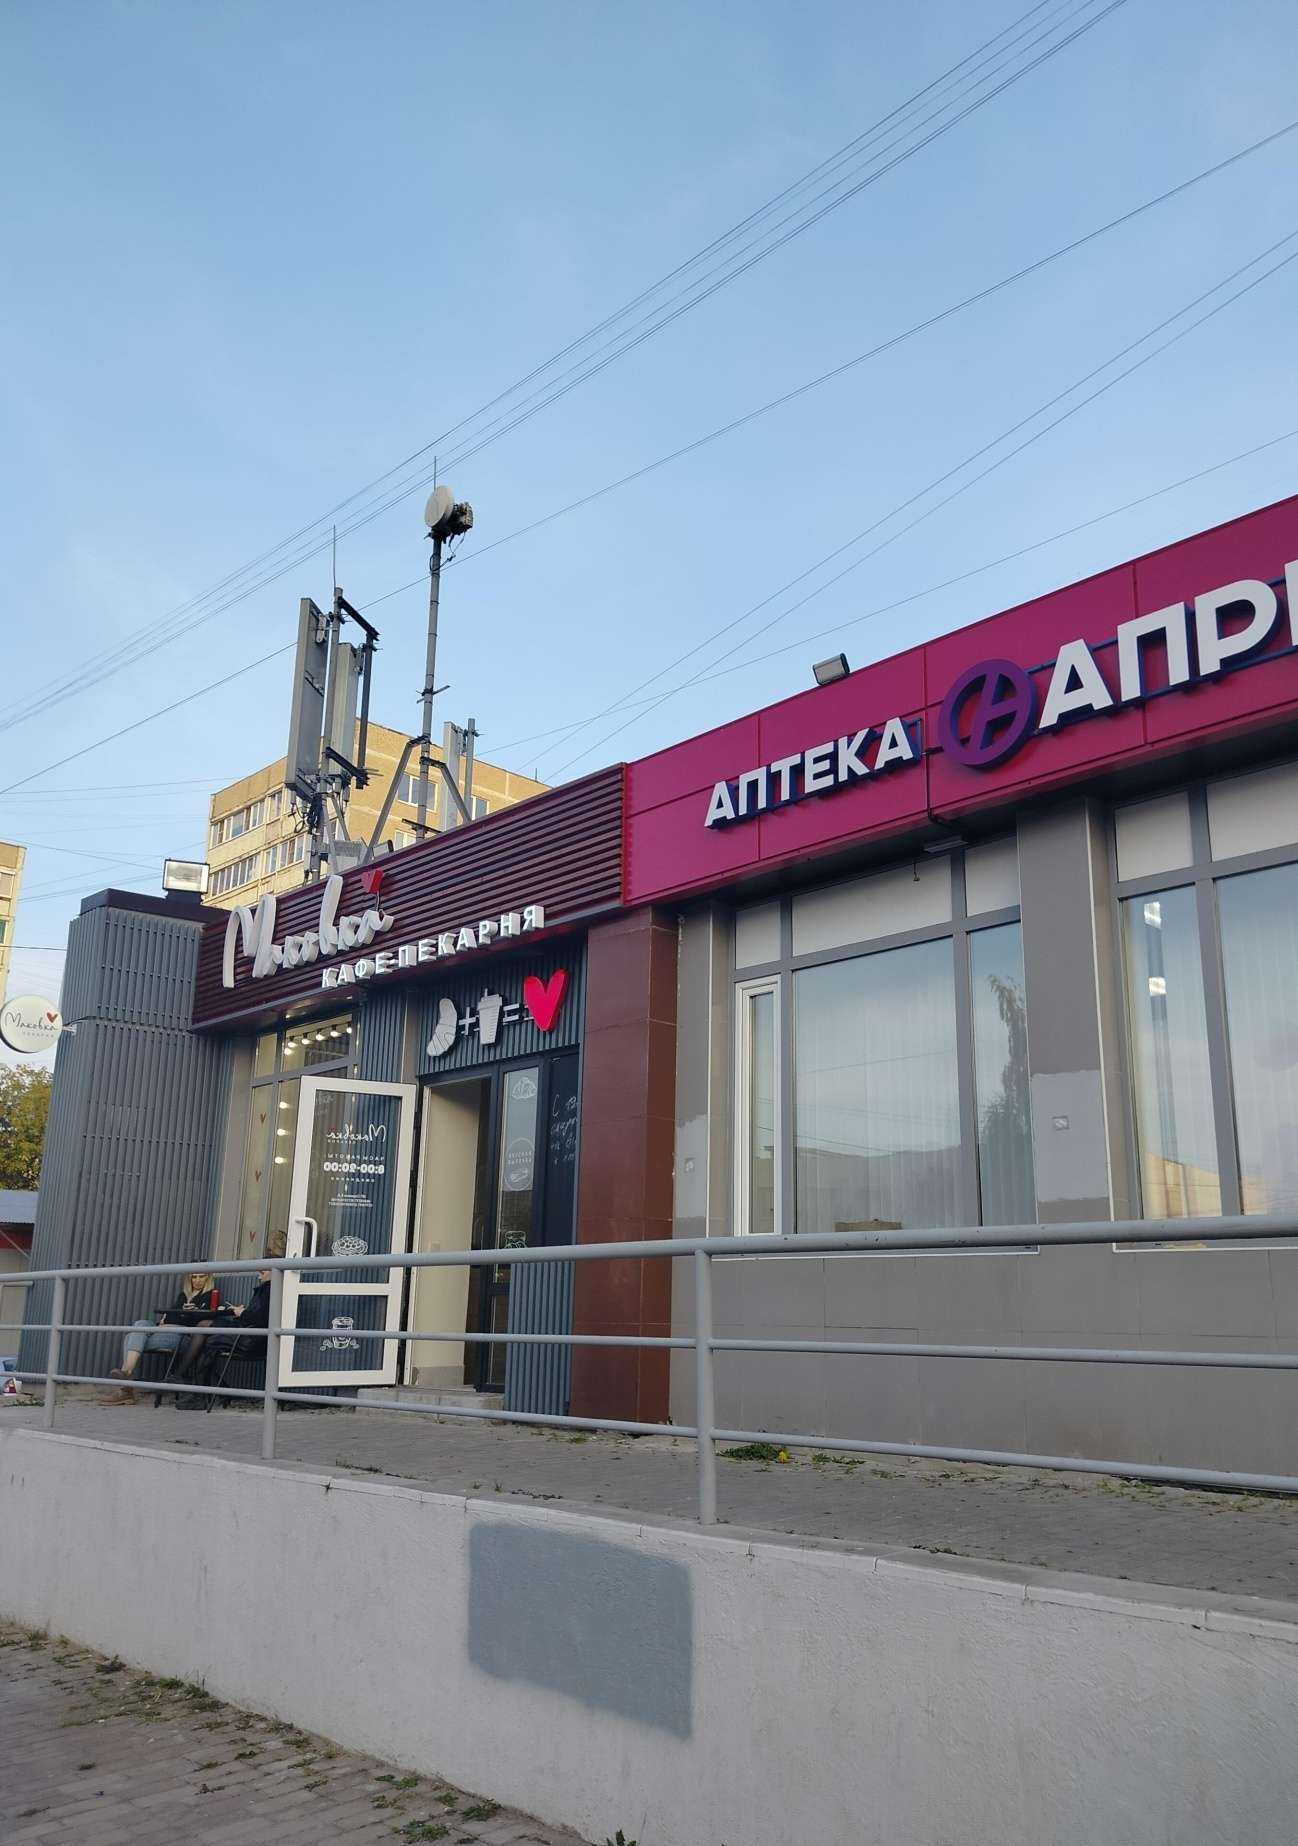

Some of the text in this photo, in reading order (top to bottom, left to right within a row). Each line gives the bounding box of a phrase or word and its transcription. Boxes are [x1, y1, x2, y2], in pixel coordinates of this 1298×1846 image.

[704, 558, 1298, 829] АПТЕКА АПР
[321, 905, 545, 988] КАФЕ-ПЕКАРНЯ
